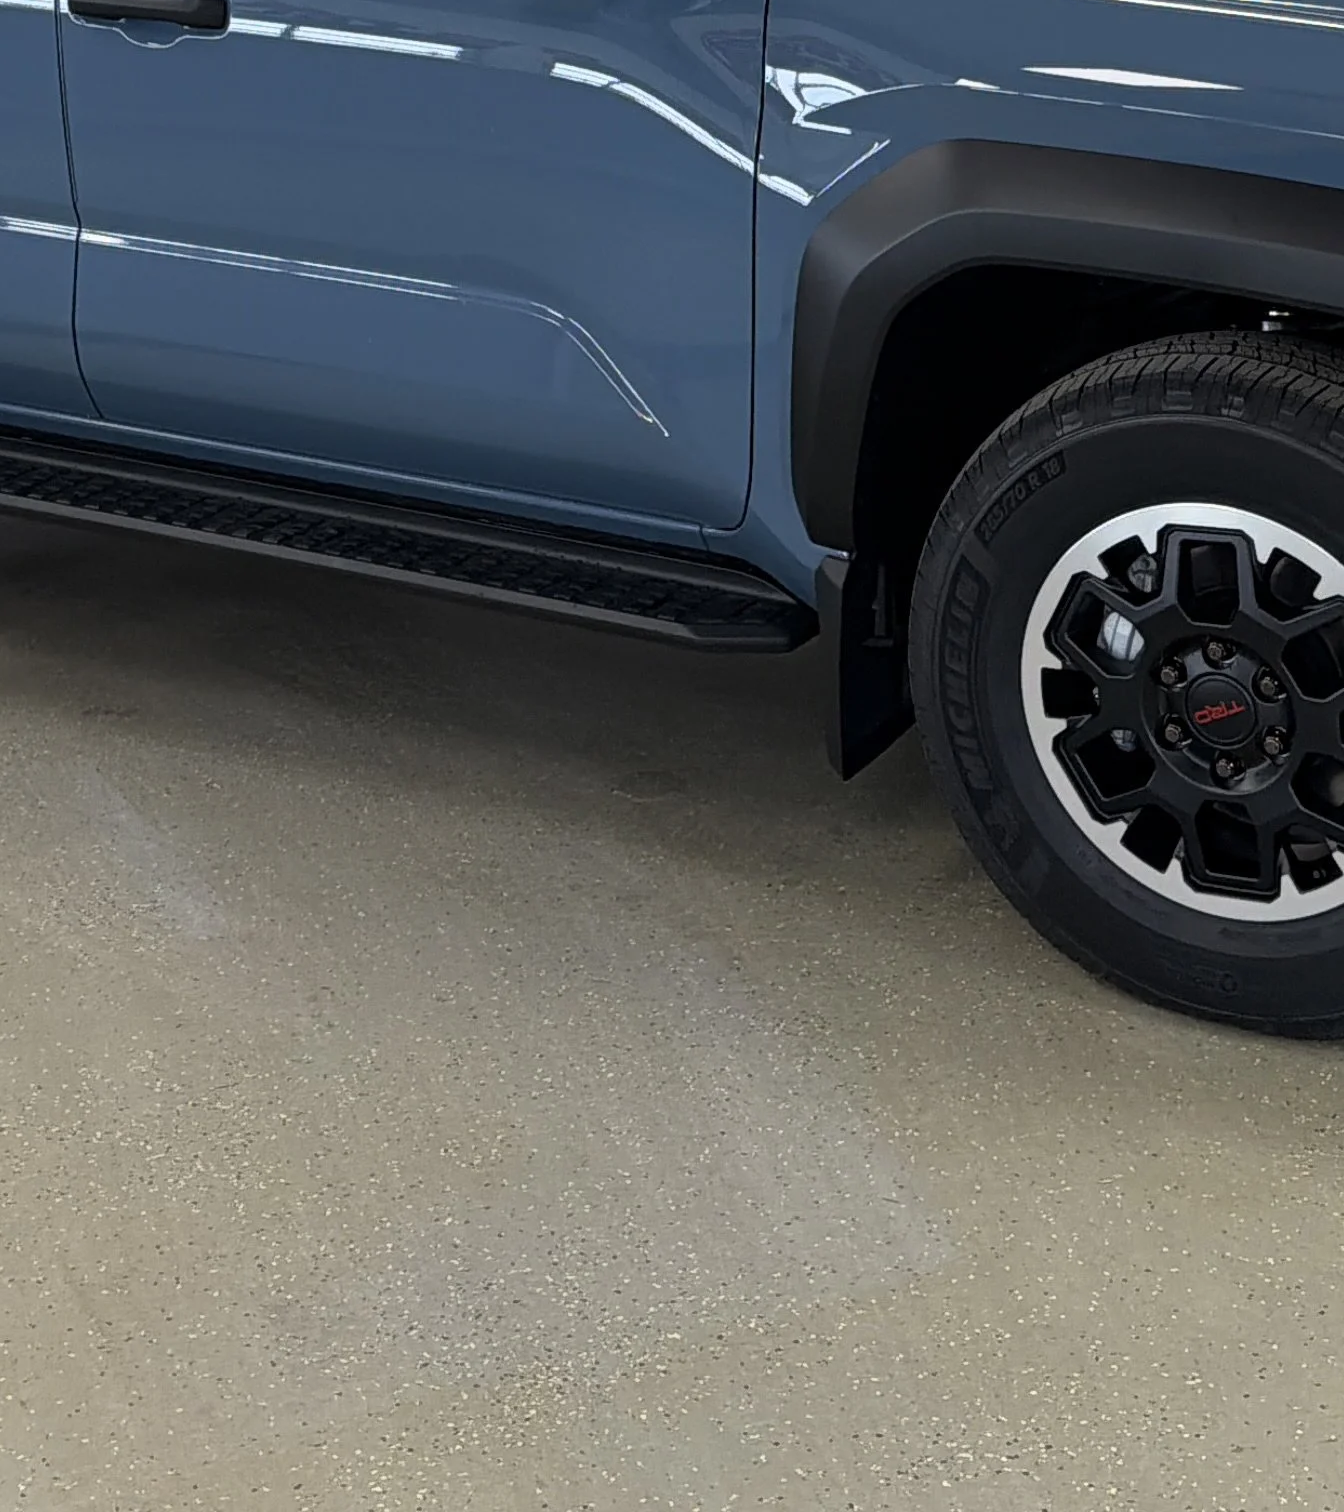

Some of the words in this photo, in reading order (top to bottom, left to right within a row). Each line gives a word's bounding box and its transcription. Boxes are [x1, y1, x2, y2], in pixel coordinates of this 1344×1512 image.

[1027, 470, 1043, 491] R
[1042, 456, 1062, 480] 18
[1193, 699, 1247, 726] TRD
